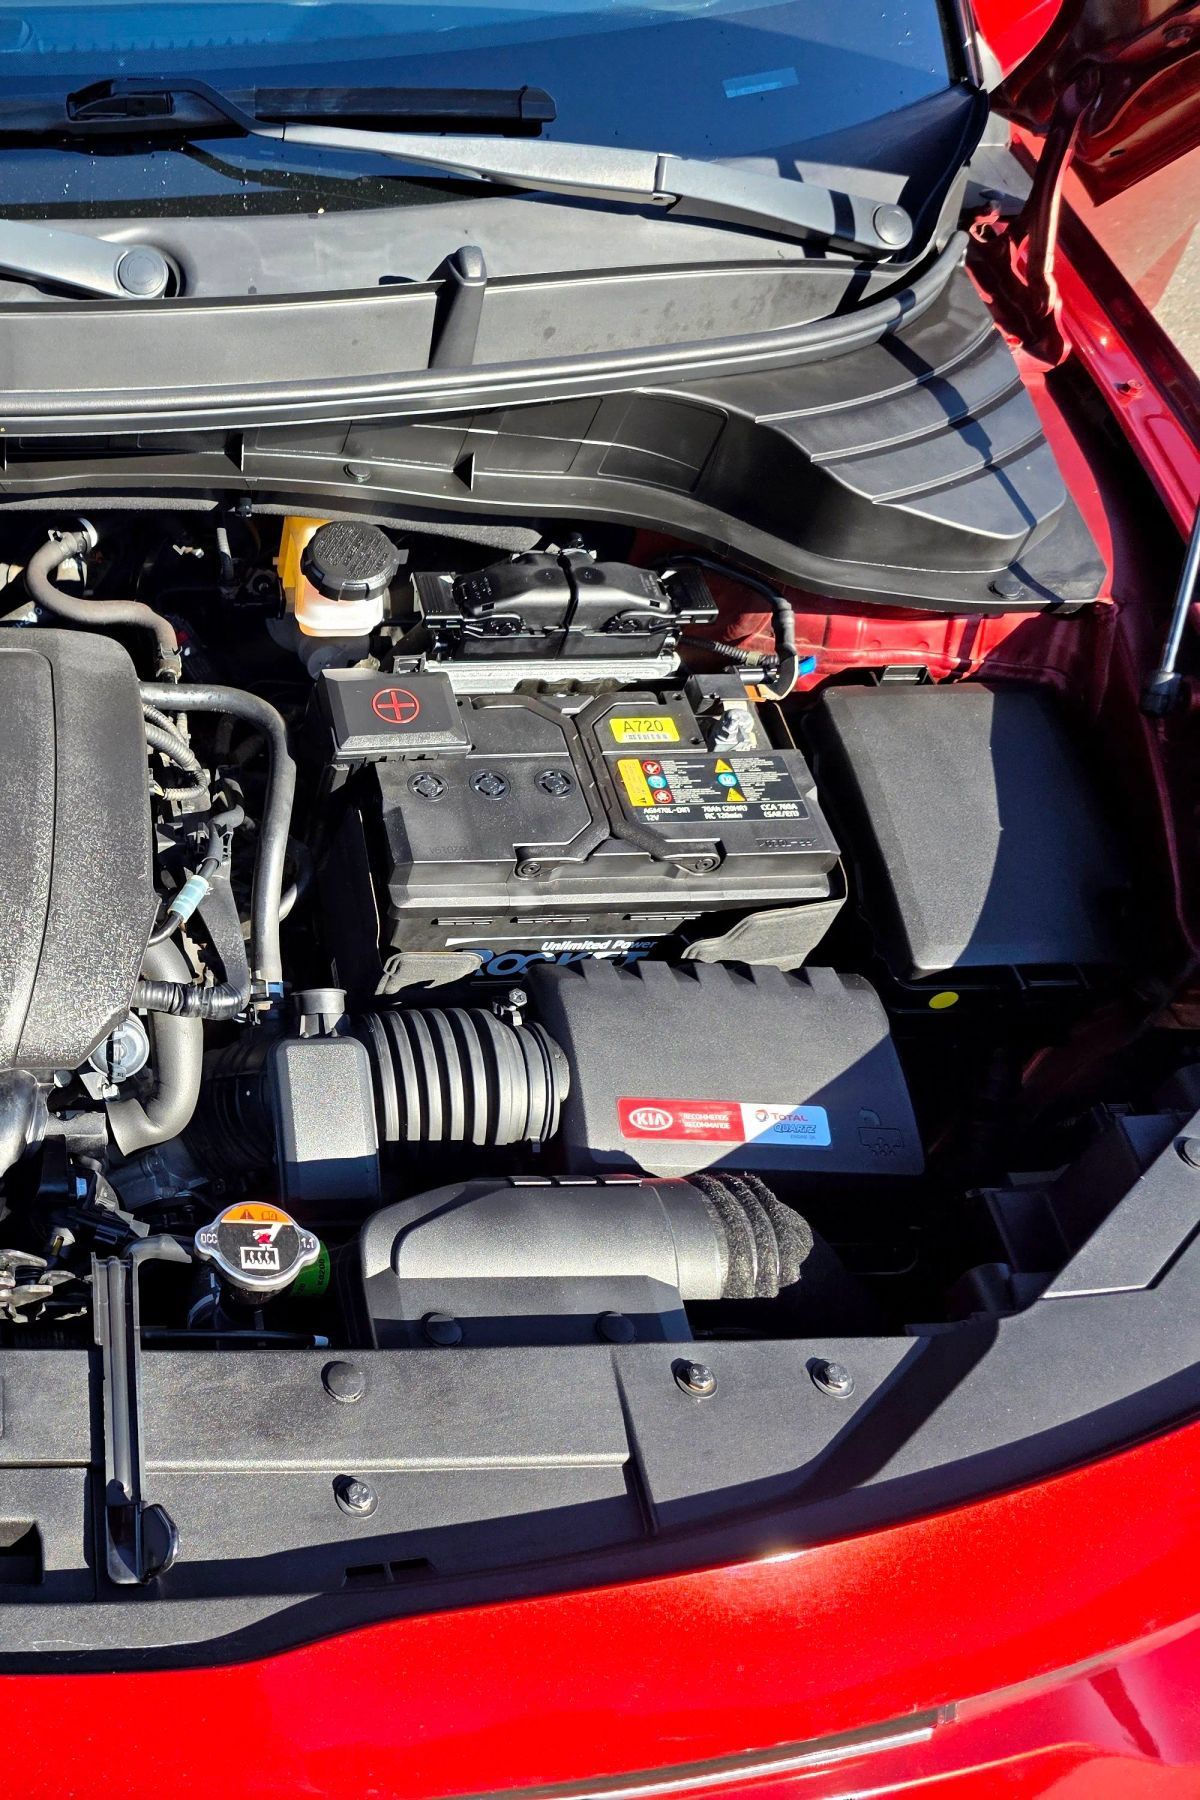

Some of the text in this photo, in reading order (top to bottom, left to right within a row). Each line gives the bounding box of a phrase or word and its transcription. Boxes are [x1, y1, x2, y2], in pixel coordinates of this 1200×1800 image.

[623, 719, 665, 733] A720
[541, 939, 659, 951] Unlimited Power
[636, 1111, 666, 1127] KIA
[771, 1112, 809, 1122] TOTAL
[773, 1122, 817, 1134] QUARTZ
[300, 1237, 315, 1249] 1.1
